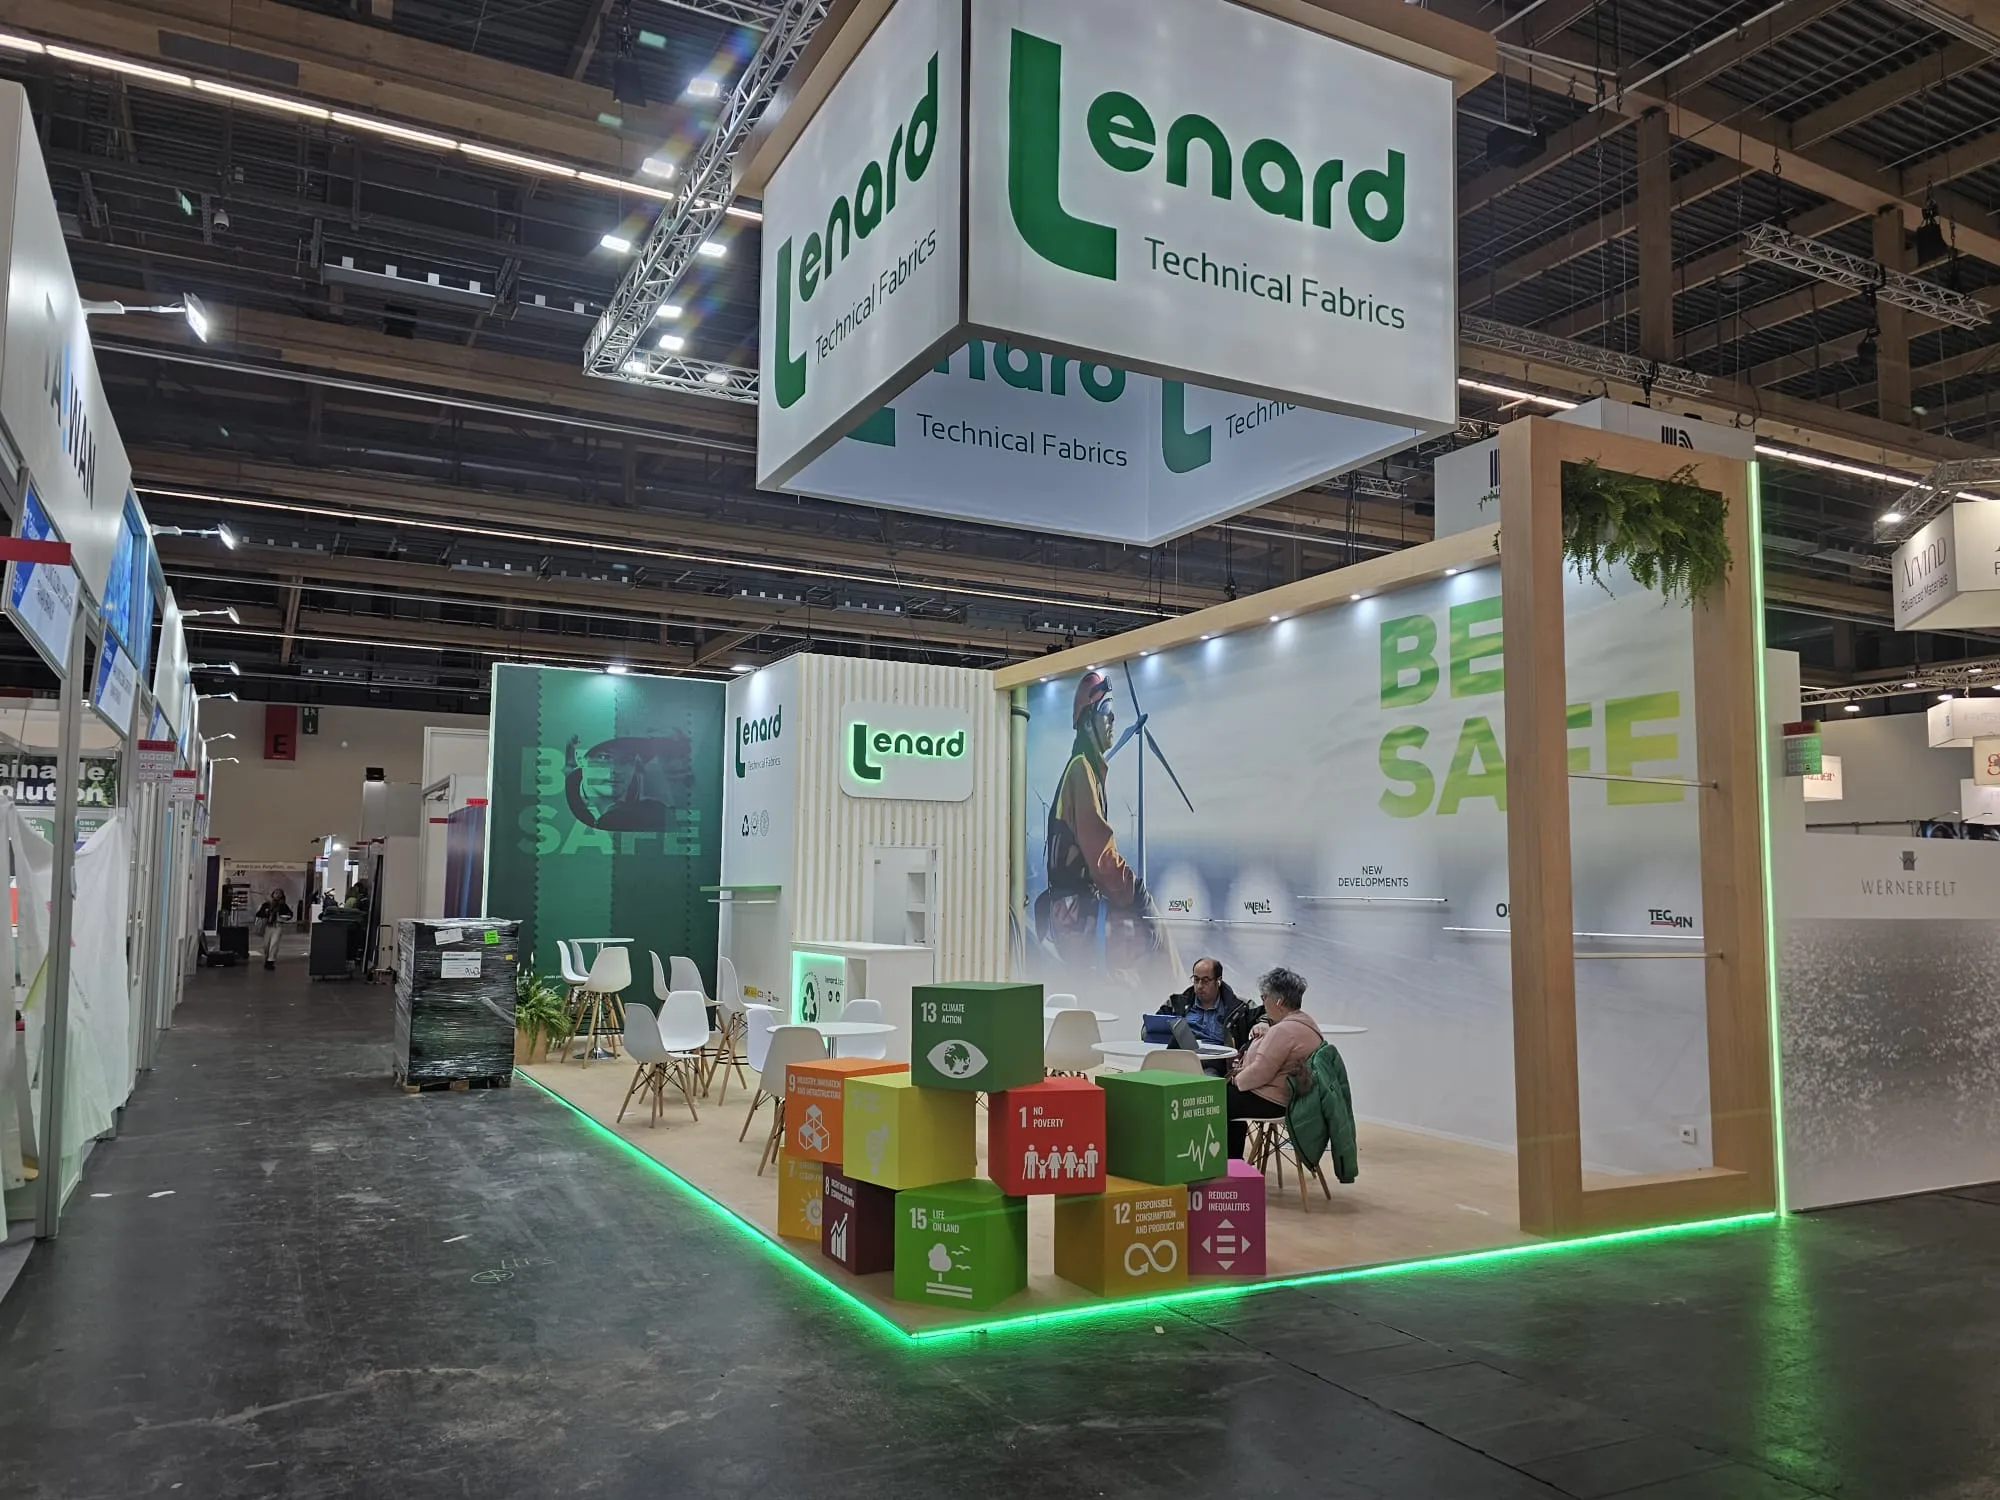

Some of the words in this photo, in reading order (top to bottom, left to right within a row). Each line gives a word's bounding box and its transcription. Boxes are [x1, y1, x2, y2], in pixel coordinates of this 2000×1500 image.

[1008, 28, 1405, 281] Lenard
[775, 49, 938, 409] Lenard
[1144, 236, 1291, 303] Technical
[1302, 278, 1405, 329] Fabrics
[815, 283, 875, 364] Technical
[878, 228, 936, 305] Fabrics
[916, 412, 1034, 454] Technical
[1043, 434, 1127, 467] Fabrics
[1380, 595, 1505, 709] BE
[273, 734, 288, 754] E
[736, 704, 782, 779] Lenard
[853, 723, 964, 781] Lenard
[517, 804, 701, 855] SAFE
[1362, 865, 1383, 875] NEW
[1338, 877, 1409, 888] DEVELOPMENTS
[1861, 877, 1957, 896] WERNERFELT
[920, 1002, 937, 1023] 13
[941, 1003, 965, 1012] CLIMATE
[941, 1015, 962, 1025] ACTION
[789, 1073, 796, 1092] 9
[1018, 1106, 1027, 1128] 1
[1033, 1106, 1044, 1115] NO
[1171, 1099, 1179, 1120] 3
[1182, 1097, 1196, 1107] GOOD
[1196, 1095, 1214, 1105] HEALTH
[1182, 1109, 1193, 1119] AND
[1033, 1118, 1064, 1128] POVERTY
[825, 1176, 830, 1195] 8
[1113, 1202, 1131, 1224] 12
[1135, 1198, 1173, 1210] RESPONSIBLE
[1188, 1191, 1203, 1211] 10
[1208, 1191, 1238, 1200] REDUCED
[1208, 1202, 1251, 1212] INEQUALITIES
[909, 1207, 928, 1229] 15
[932, 1209, 945, 1220] LIFE
[1135, 1209, 1177, 1222] CONSUMPTION
[932, 1222, 942, 1232] ON
[943, 1223, 960, 1234] LAND
[1135, 1224, 1148, 1235] AND
